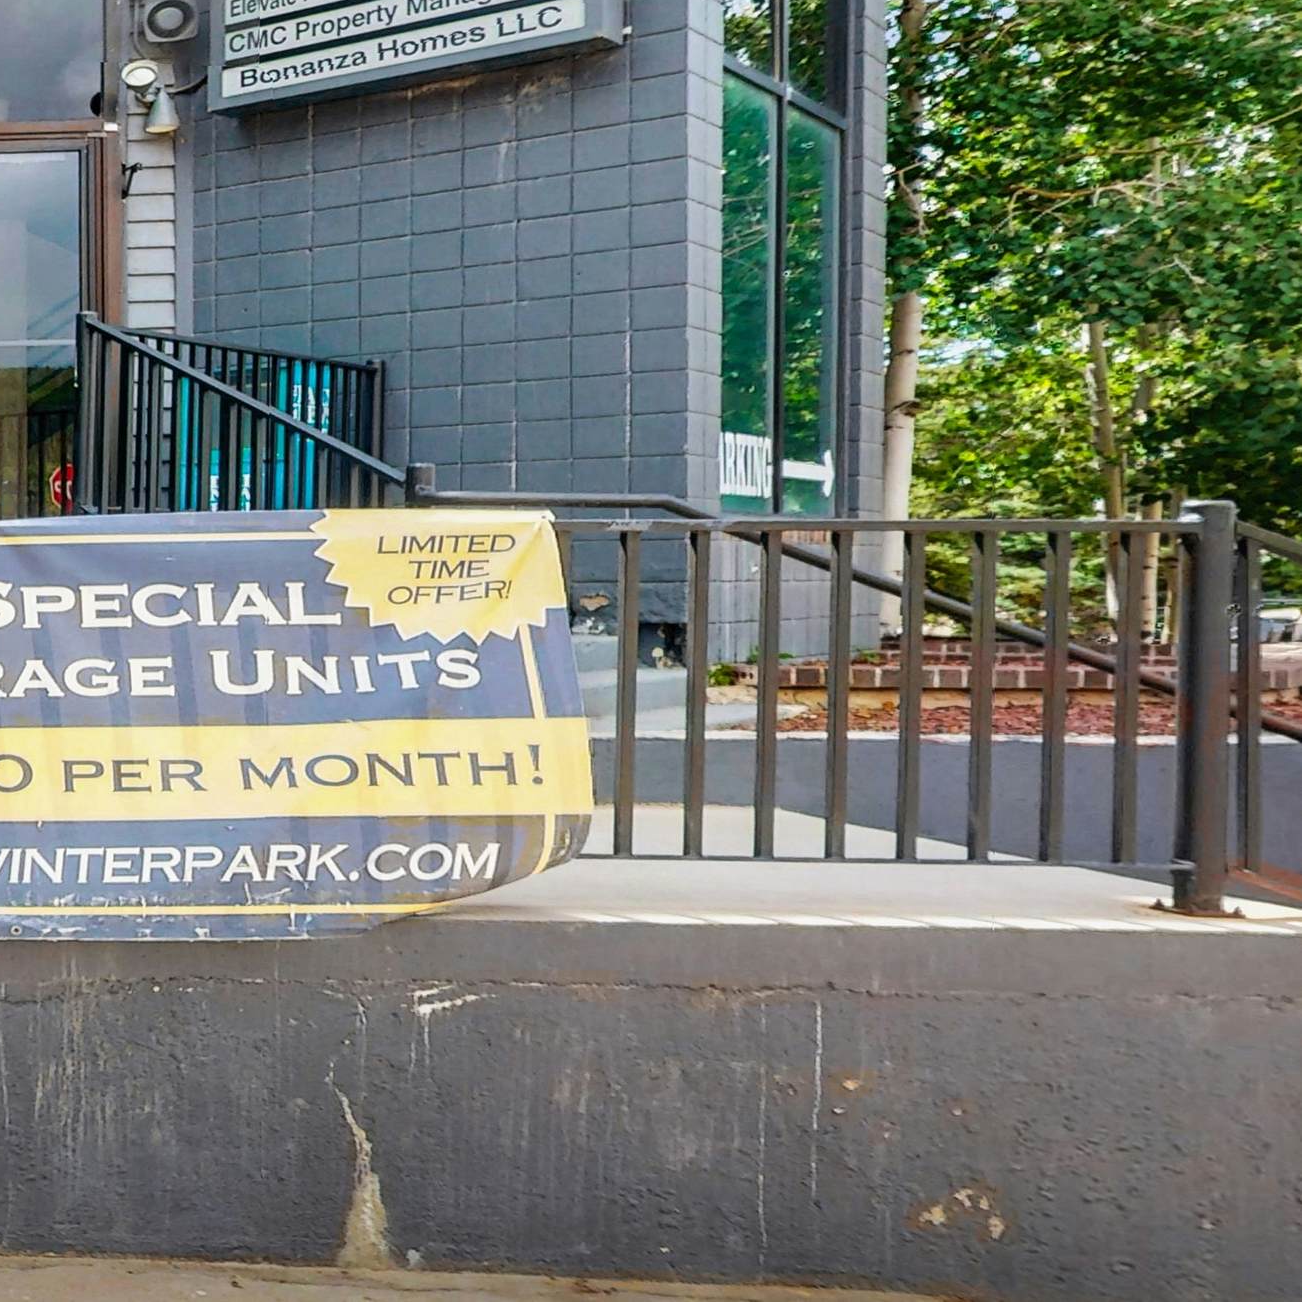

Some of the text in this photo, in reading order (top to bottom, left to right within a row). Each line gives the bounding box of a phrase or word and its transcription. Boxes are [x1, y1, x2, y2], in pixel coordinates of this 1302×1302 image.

[228, 27, 287, 53] CMC
[296, 4, 398, 40] Property
[240, 6, 563, 88] Bonanza Homes LLC
[377, 534, 516, 555] LIMITED
[387, 579, 512, 605] OFFER!
[408, 560, 490, 579] TIME
[209, 649, 481, 695] UNITS
[62, 757, 206, 793] PER
[239, 744, 543, 789] MONTH!
